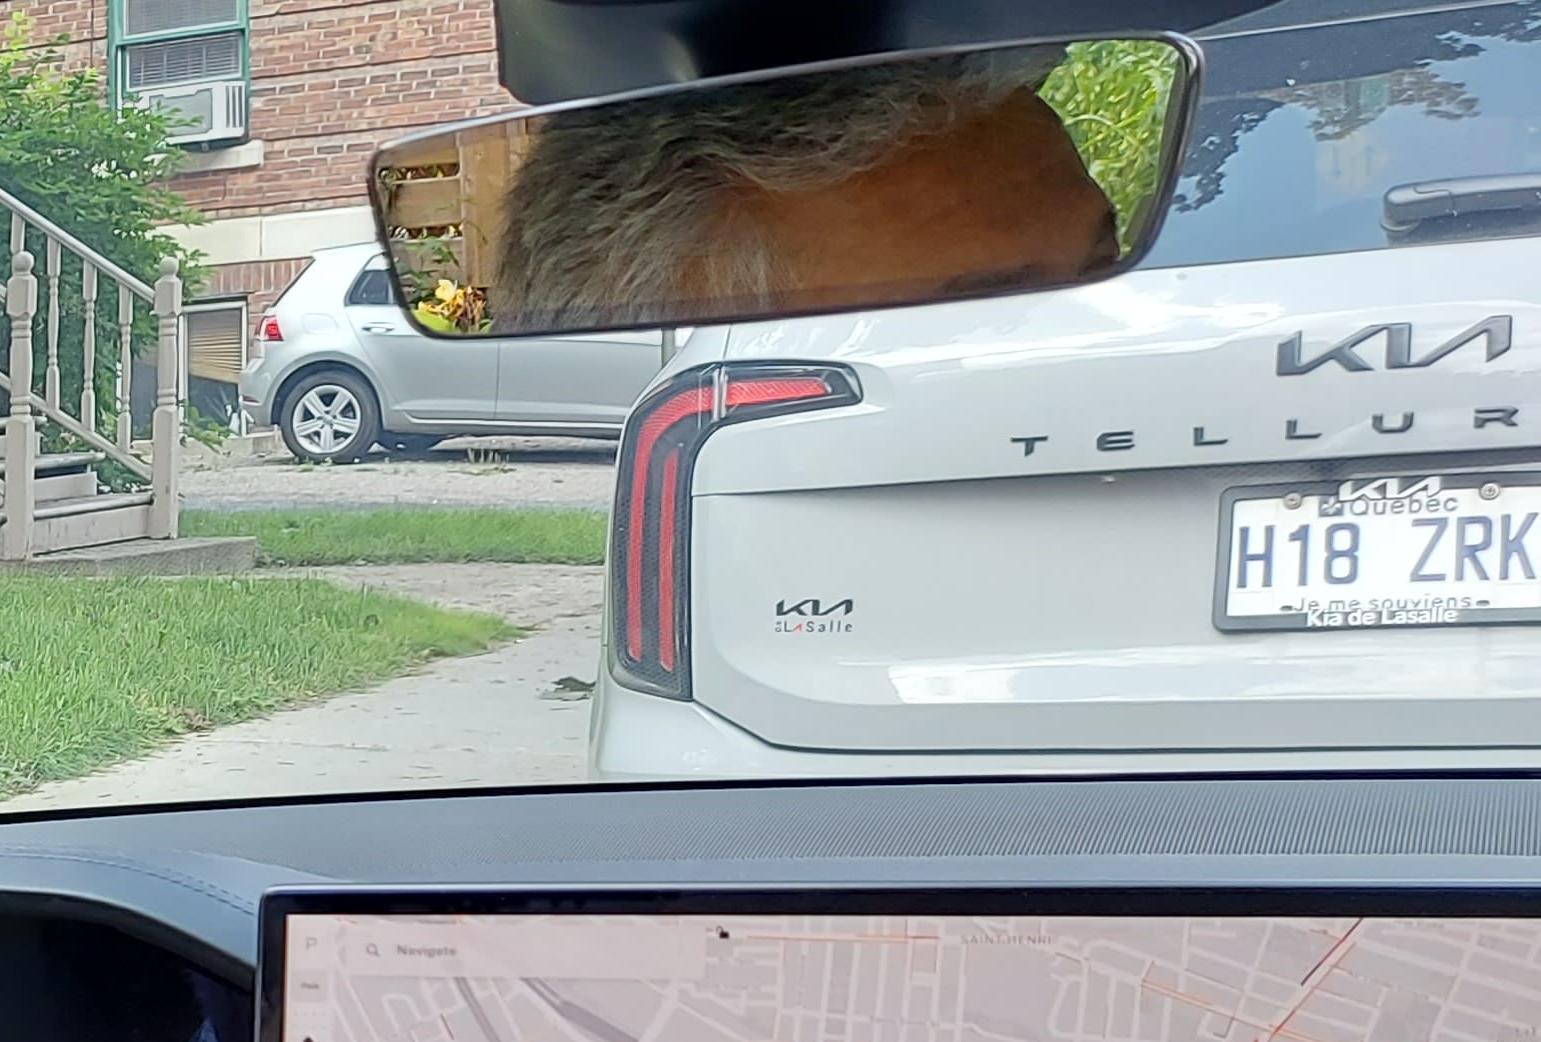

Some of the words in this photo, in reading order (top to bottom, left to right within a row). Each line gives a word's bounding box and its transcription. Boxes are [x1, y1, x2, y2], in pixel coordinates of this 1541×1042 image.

[1276, 314, 1513, 377] KIA
[1010, 405, 1519, 457] TELLUR
[1236, 522, 1360, 589] H18
[1409, 511, 1541, 583] ZRK
[775, 598, 853, 616] KIA
[1307, 609, 1343, 628] Kia
[1347, 608, 1376, 626] de
[1381, 605, 1459, 625] Lasalle
[1328, 599, 1361, 611] me
[1368, 593, 1473, 610] souviens
